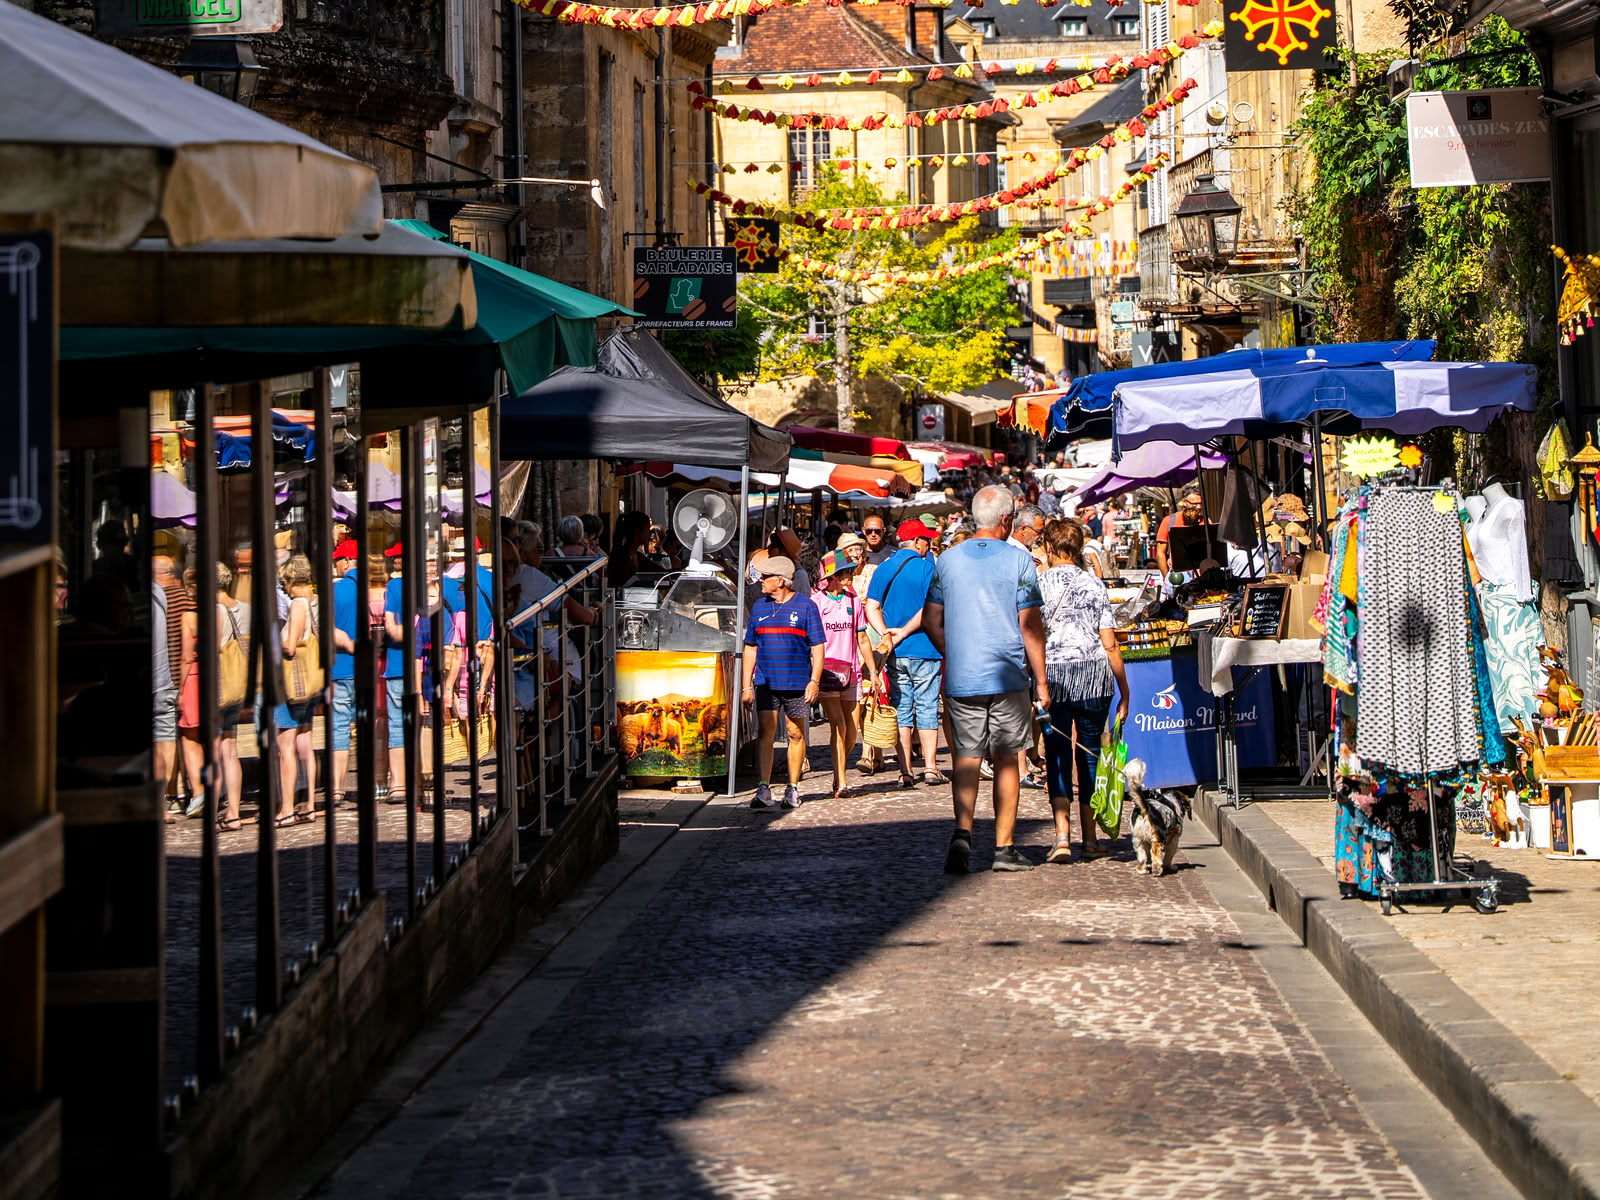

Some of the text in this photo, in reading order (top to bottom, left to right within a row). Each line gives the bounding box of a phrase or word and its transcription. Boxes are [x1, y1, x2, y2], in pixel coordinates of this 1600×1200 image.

[1412, 119, 1548, 139] ESCAPADES-ZEN
[646, 249, 722, 261] BRULERIE
[636, 262, 733, 275] SARLADAISE
[825, 621, 852, 631] Rakute
[1135, 713, 1195, 732] Maison
